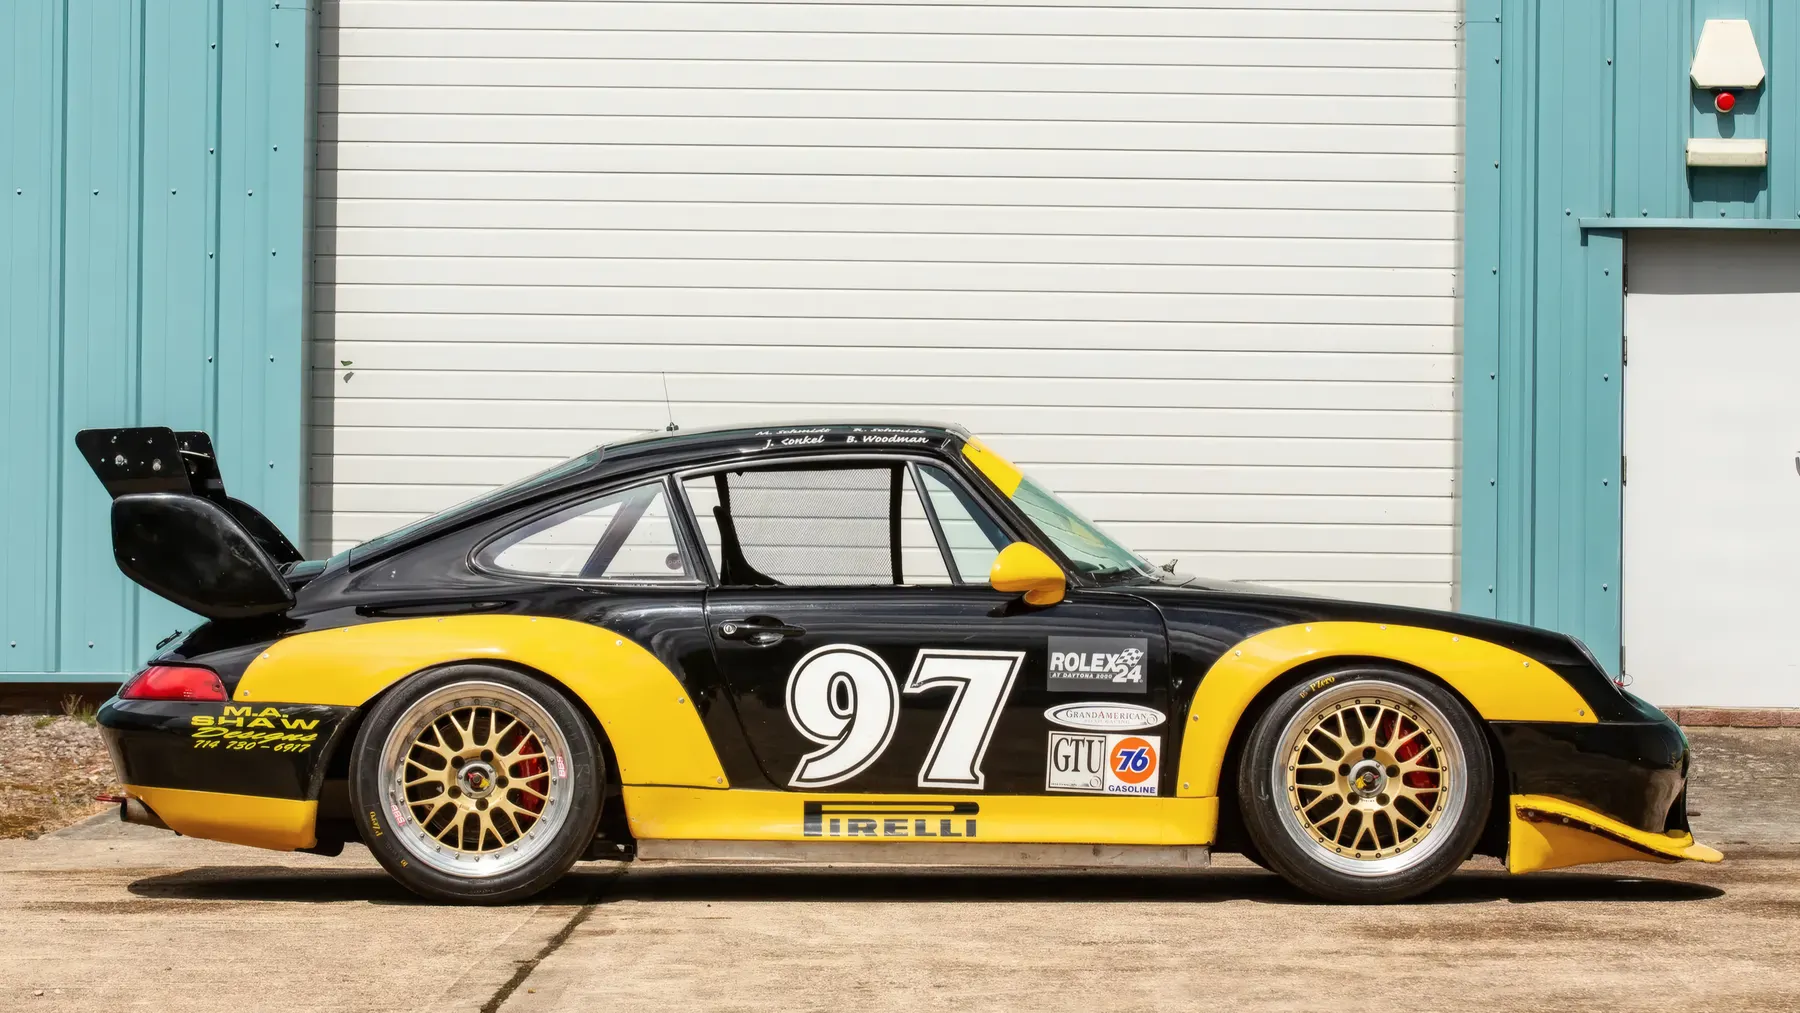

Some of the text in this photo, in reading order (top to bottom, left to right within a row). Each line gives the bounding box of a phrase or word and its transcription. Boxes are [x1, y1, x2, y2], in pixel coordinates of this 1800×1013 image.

[762, 435, 825, 450] J. Conkel
[846, 434, 929, 444] B. Woodman
[1050, 652, 1143, 683] ROLEX 24
[223, 706, 289, 718] M.A.
[785, 643, 1027, 790] 97
[191, 715, 320, 730] SHAW
[191, 727, 318, 744] Designs
[194, 740, 220, 749] 714
[225, 741, 256, 750] 730
[273, 743, 311, 753] 6917
[1053, 736, 1105, 774] GTU
[1116, 747, 1150, 773] 76
[1108, 784, 1156, 794] GASOLINE
[391, 804, 406, 826] BBS
[803, 801, 980, 837] PIRELLI
